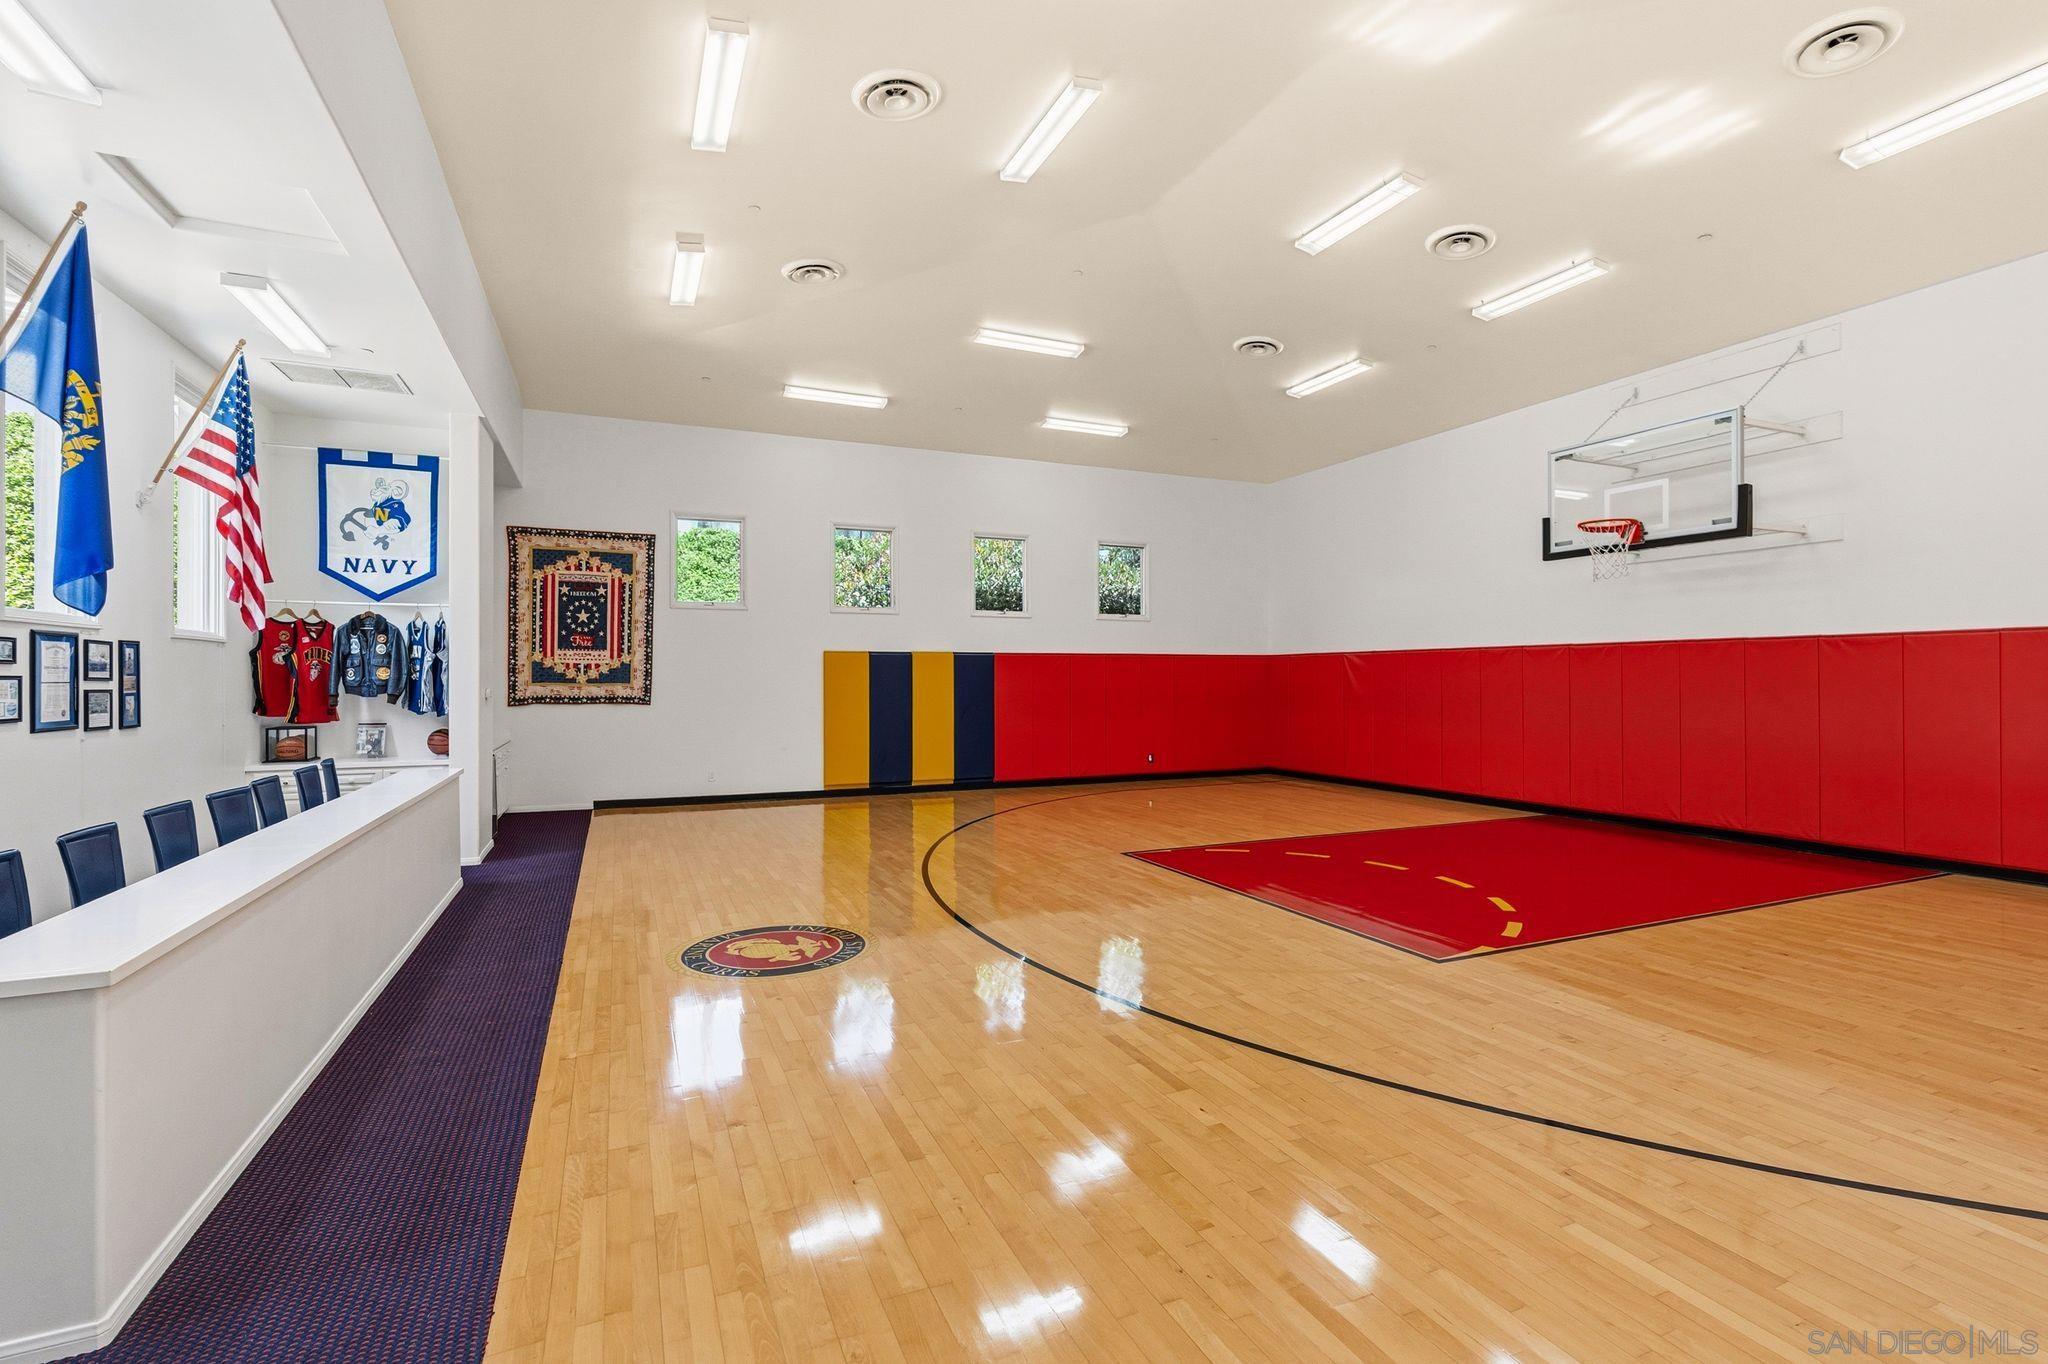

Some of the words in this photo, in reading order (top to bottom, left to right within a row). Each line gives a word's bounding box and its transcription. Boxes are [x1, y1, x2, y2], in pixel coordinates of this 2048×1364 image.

[373, 508, 390, 522] N
[342, 557, 417, 575] NAVY
[788, 925, 857, 940] UNITED
[684, 932, 741, 966] MARINE
[813, 941, 863, 968] STATES
[690, 961, 761, 977] CORPS
